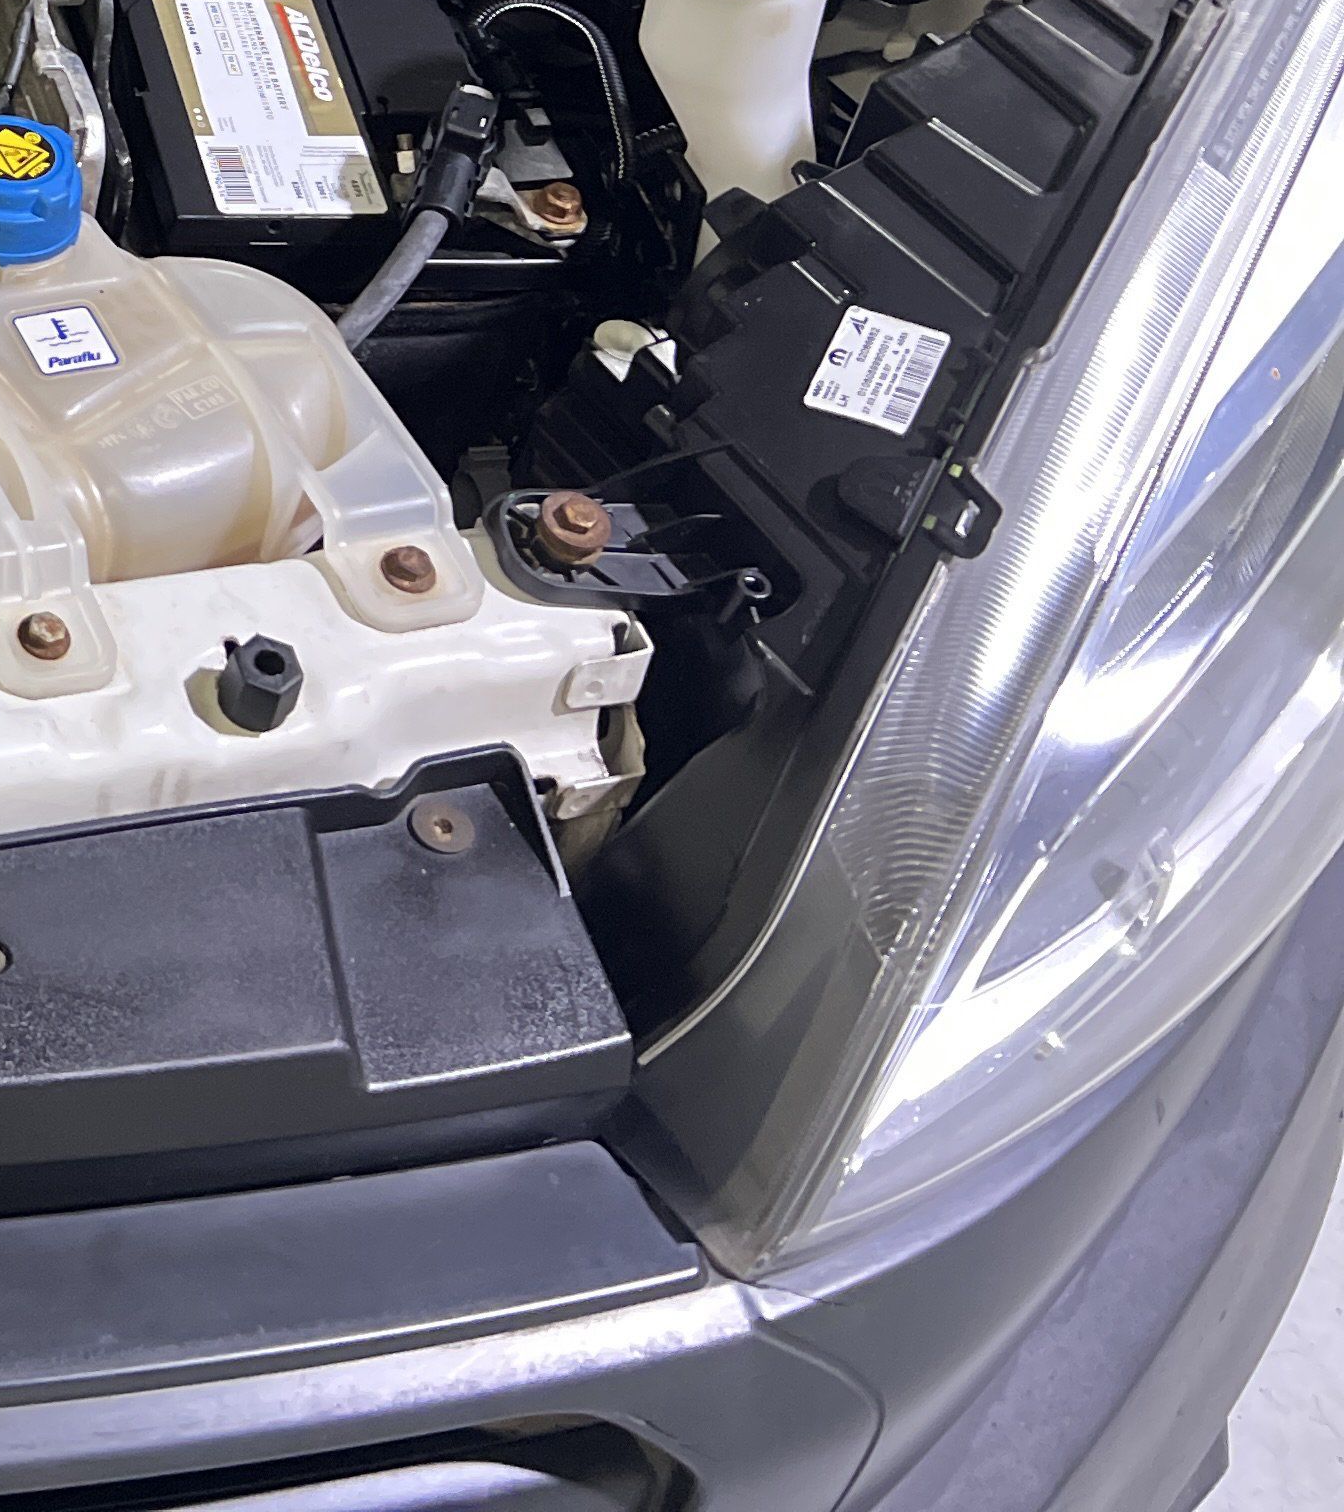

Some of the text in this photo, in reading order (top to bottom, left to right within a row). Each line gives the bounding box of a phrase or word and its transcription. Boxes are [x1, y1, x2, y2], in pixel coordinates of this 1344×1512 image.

[244, 2, 289, 110] MAINTENANCE FREE BATTERY
[283, 5, 334, 102] ACDelco
[49, 351, 101, 368] Paraflu
